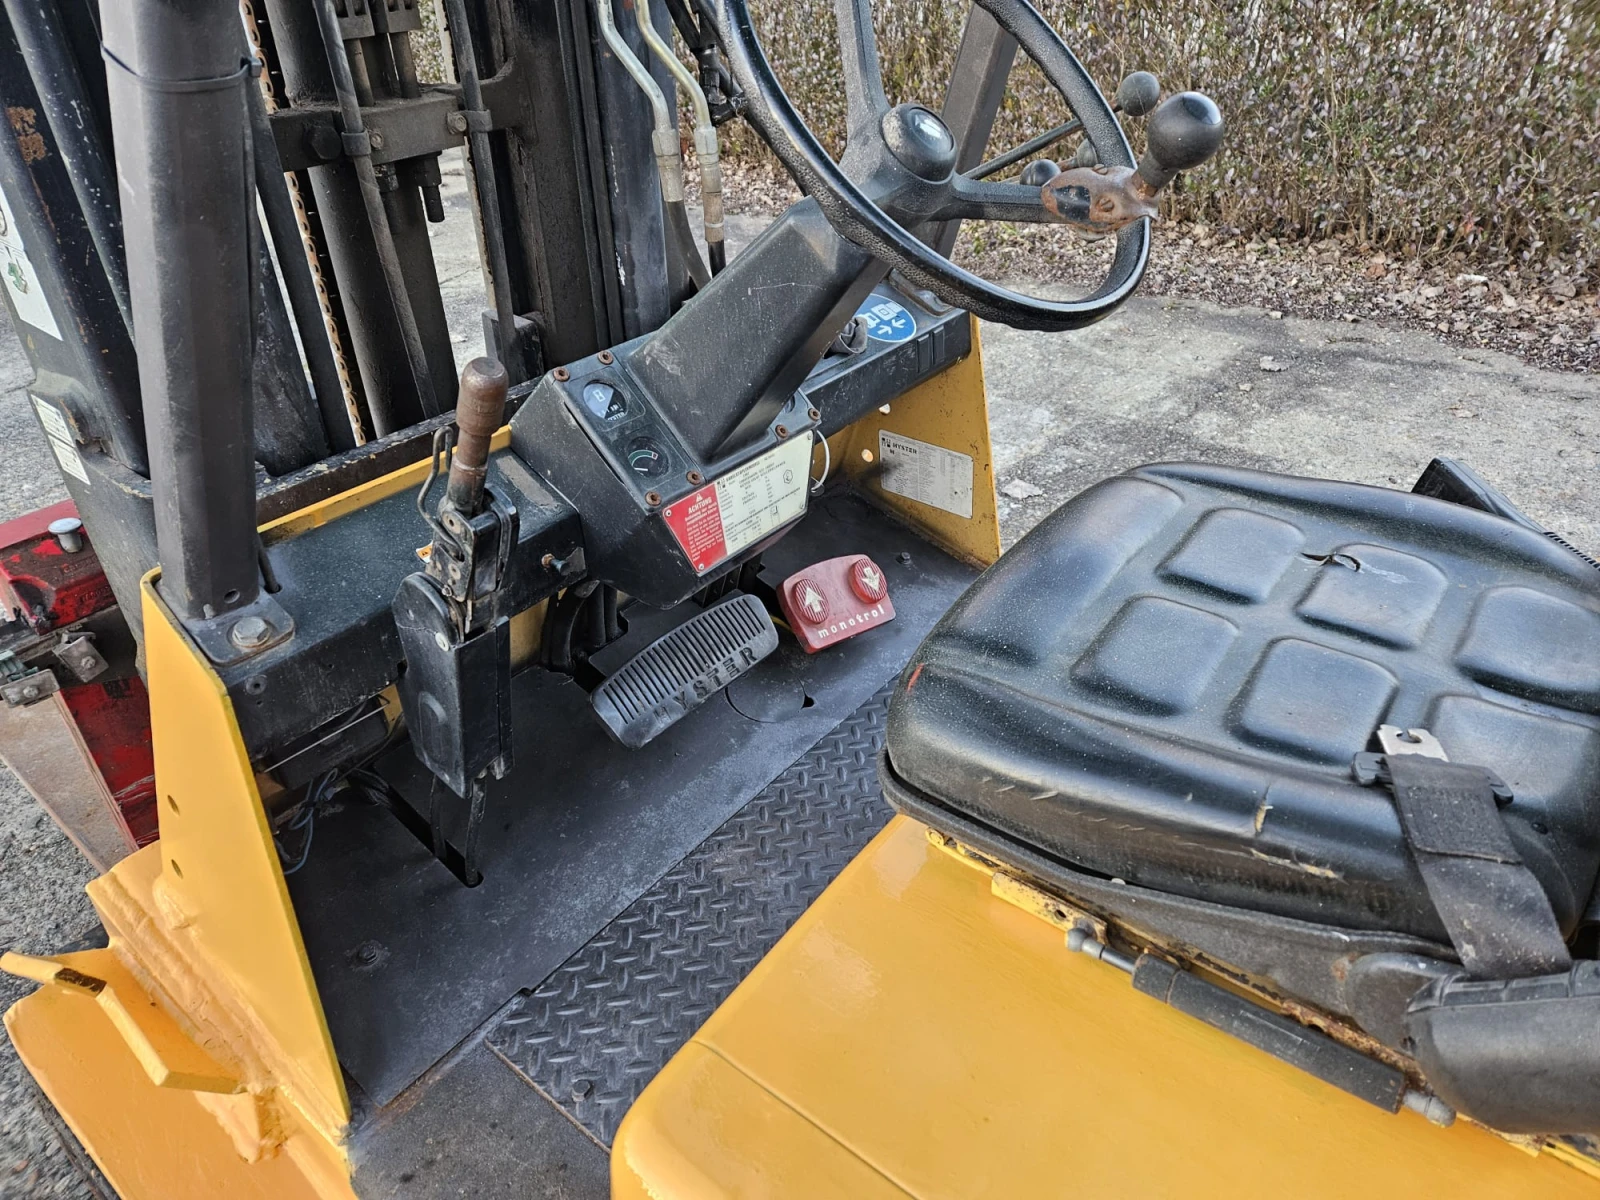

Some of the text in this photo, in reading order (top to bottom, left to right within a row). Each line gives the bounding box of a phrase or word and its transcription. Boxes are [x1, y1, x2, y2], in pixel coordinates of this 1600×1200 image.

[892, 442, 917, 454] HYSTER
[688, 496, 712, 514] ACHTUNG
[818, 604, 884, 638] monotrol
[653, 647, 757, 722] HYSTER
